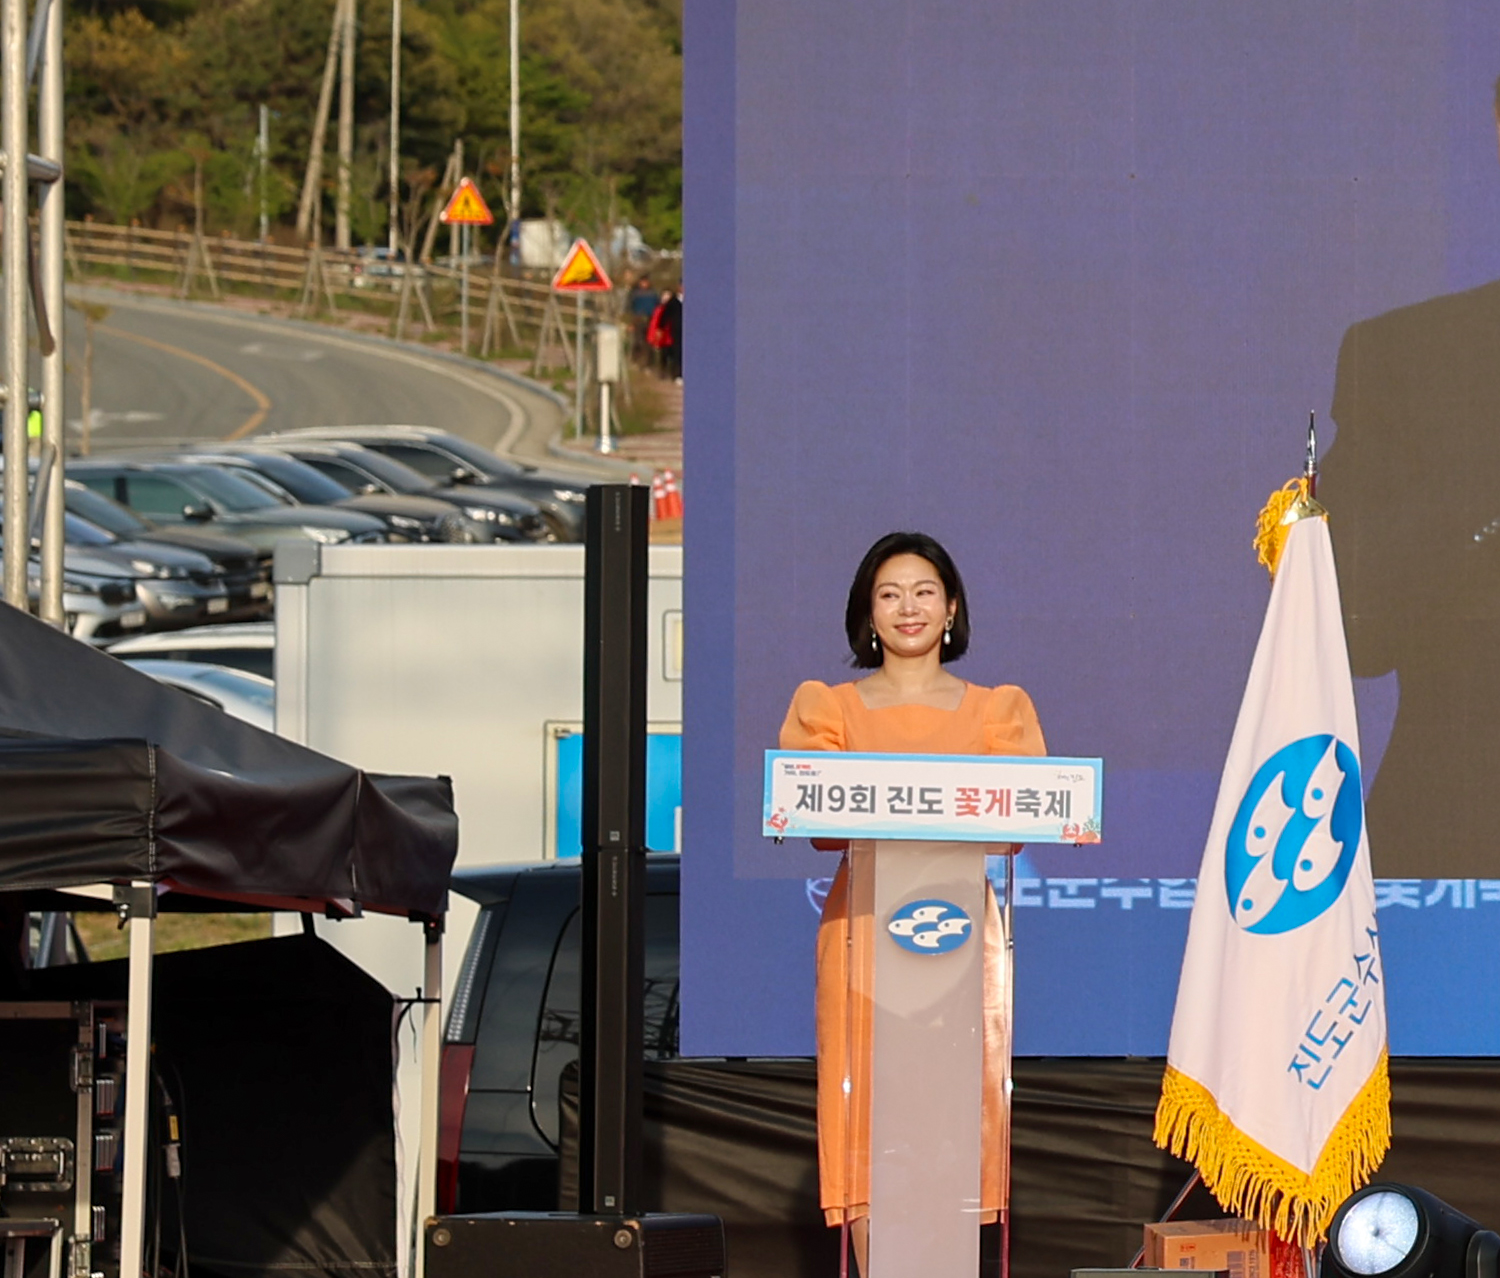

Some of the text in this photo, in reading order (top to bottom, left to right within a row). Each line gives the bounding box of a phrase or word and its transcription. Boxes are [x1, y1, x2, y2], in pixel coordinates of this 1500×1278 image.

[795, 783, 1072, 819] 제9회 진도 꽃게축제
[1286, 913, 1380, 1090] 진도군수
